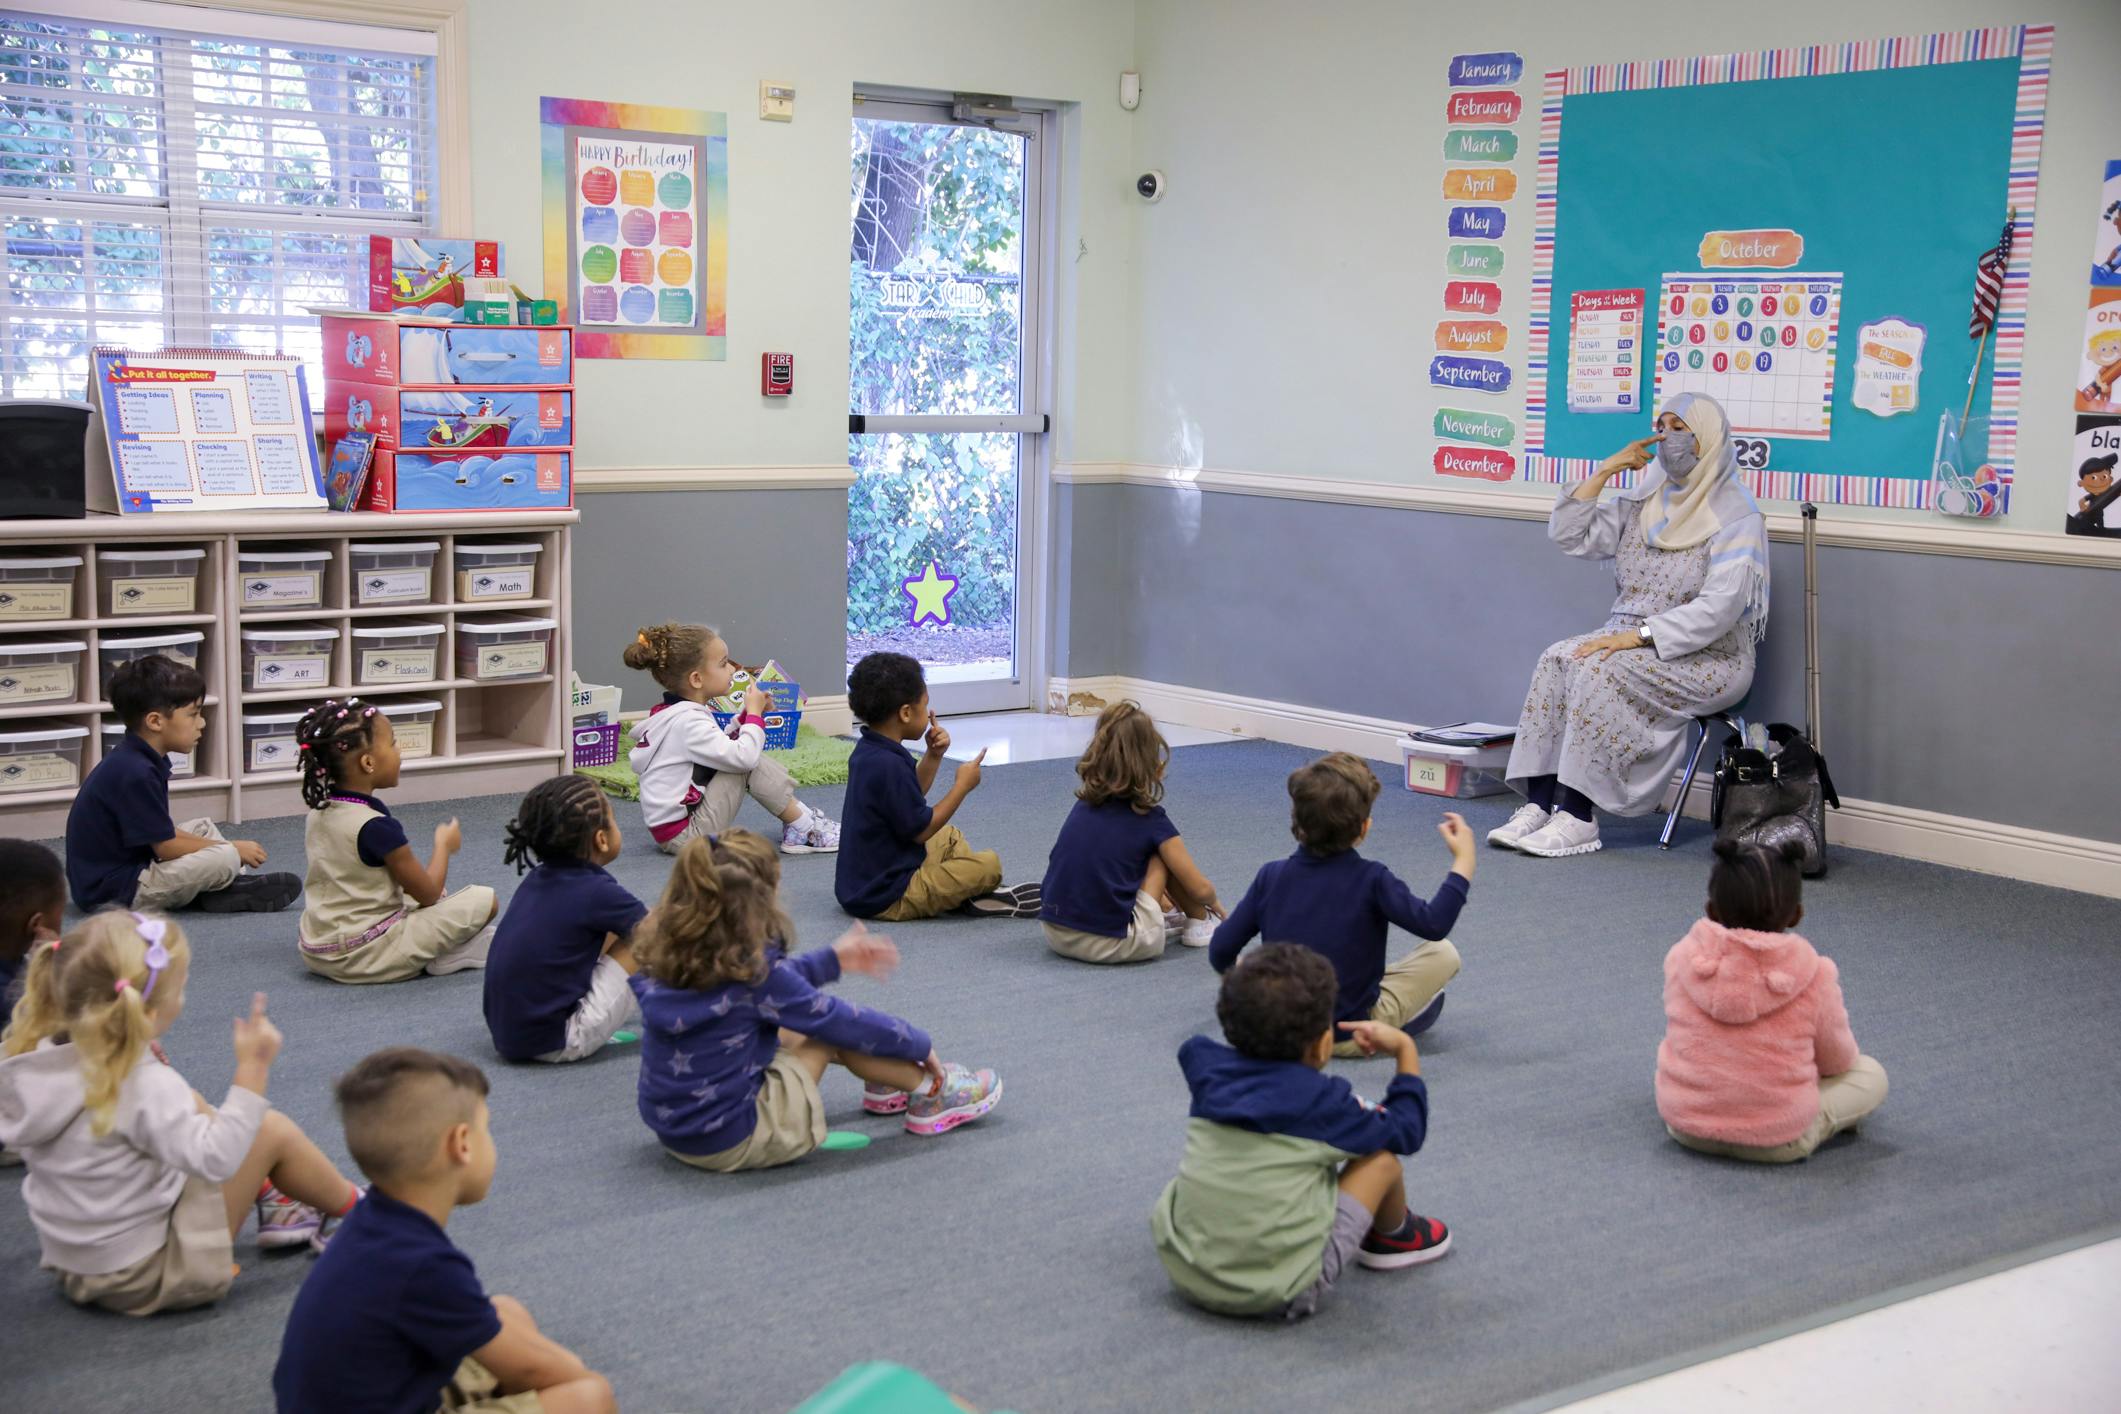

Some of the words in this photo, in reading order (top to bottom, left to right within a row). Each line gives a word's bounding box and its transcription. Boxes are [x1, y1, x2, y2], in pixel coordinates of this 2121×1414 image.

[1458, 60, 1511, 81] January
[1454, 98, 1513, 119] February
[1460, 135, 1500, 153] March
[580, 144, 611, 161] HAPPY
[614, 144, 693, 171] Birthday!
[1462, 174, 1495, 198] April
[1462, 211, 1490, 234] May
[1719, 239, 1781, 259] October
[1460, 250, 1489, 268] June
[880, 280, 918, 304] STAR
[945, 280, 987, 304] CHILD
[1459, 287, 1486, 310] July
[1578, 294, 1603, 309] Days
[1612, 293, 1637, 305] Week
[1717, 297, 1723, 311] 3
[1765, 299, 1772, 312] 5
[1815, 298, 1822, 312] 7
[903, 308, 954, 321] Academy
[1448, 325, 1493, 349] August
[1672, 329, 1679, 342] 8
[1716, 325, 1726, 337] 10
[1763, 330, 1773, 343] 12
[1785, 329, 1793, 342] 13
[771, 355, 791, 365] FIRE
[1667, 355, 1677, 368] 15
[1691, 352, 1700, 365] 16
[1717, 356, 1724, 369] 17
[128, 370, 145, 378] Put
[147, 370, 154, 378] it
[156, 370, 167, 379] all
[168, 371, 212, 381] together.
[248, 372, 273, 381] Writing
[1436, 359, 1503, 385] September
[1873, 371, 1906, 381] WEATHER
[120, 391, 148, 399] Getting
[194, 391, 225, 399] Planning
[1442, 414, 1505, 439] November
[122, 444, 152, 452] Revising
[1733, 439, 1768, 468] 23
[1443, 451, 1505, 474] December
[499, 582, 522, 592] Math
[294, 669, 310, 678] ART
